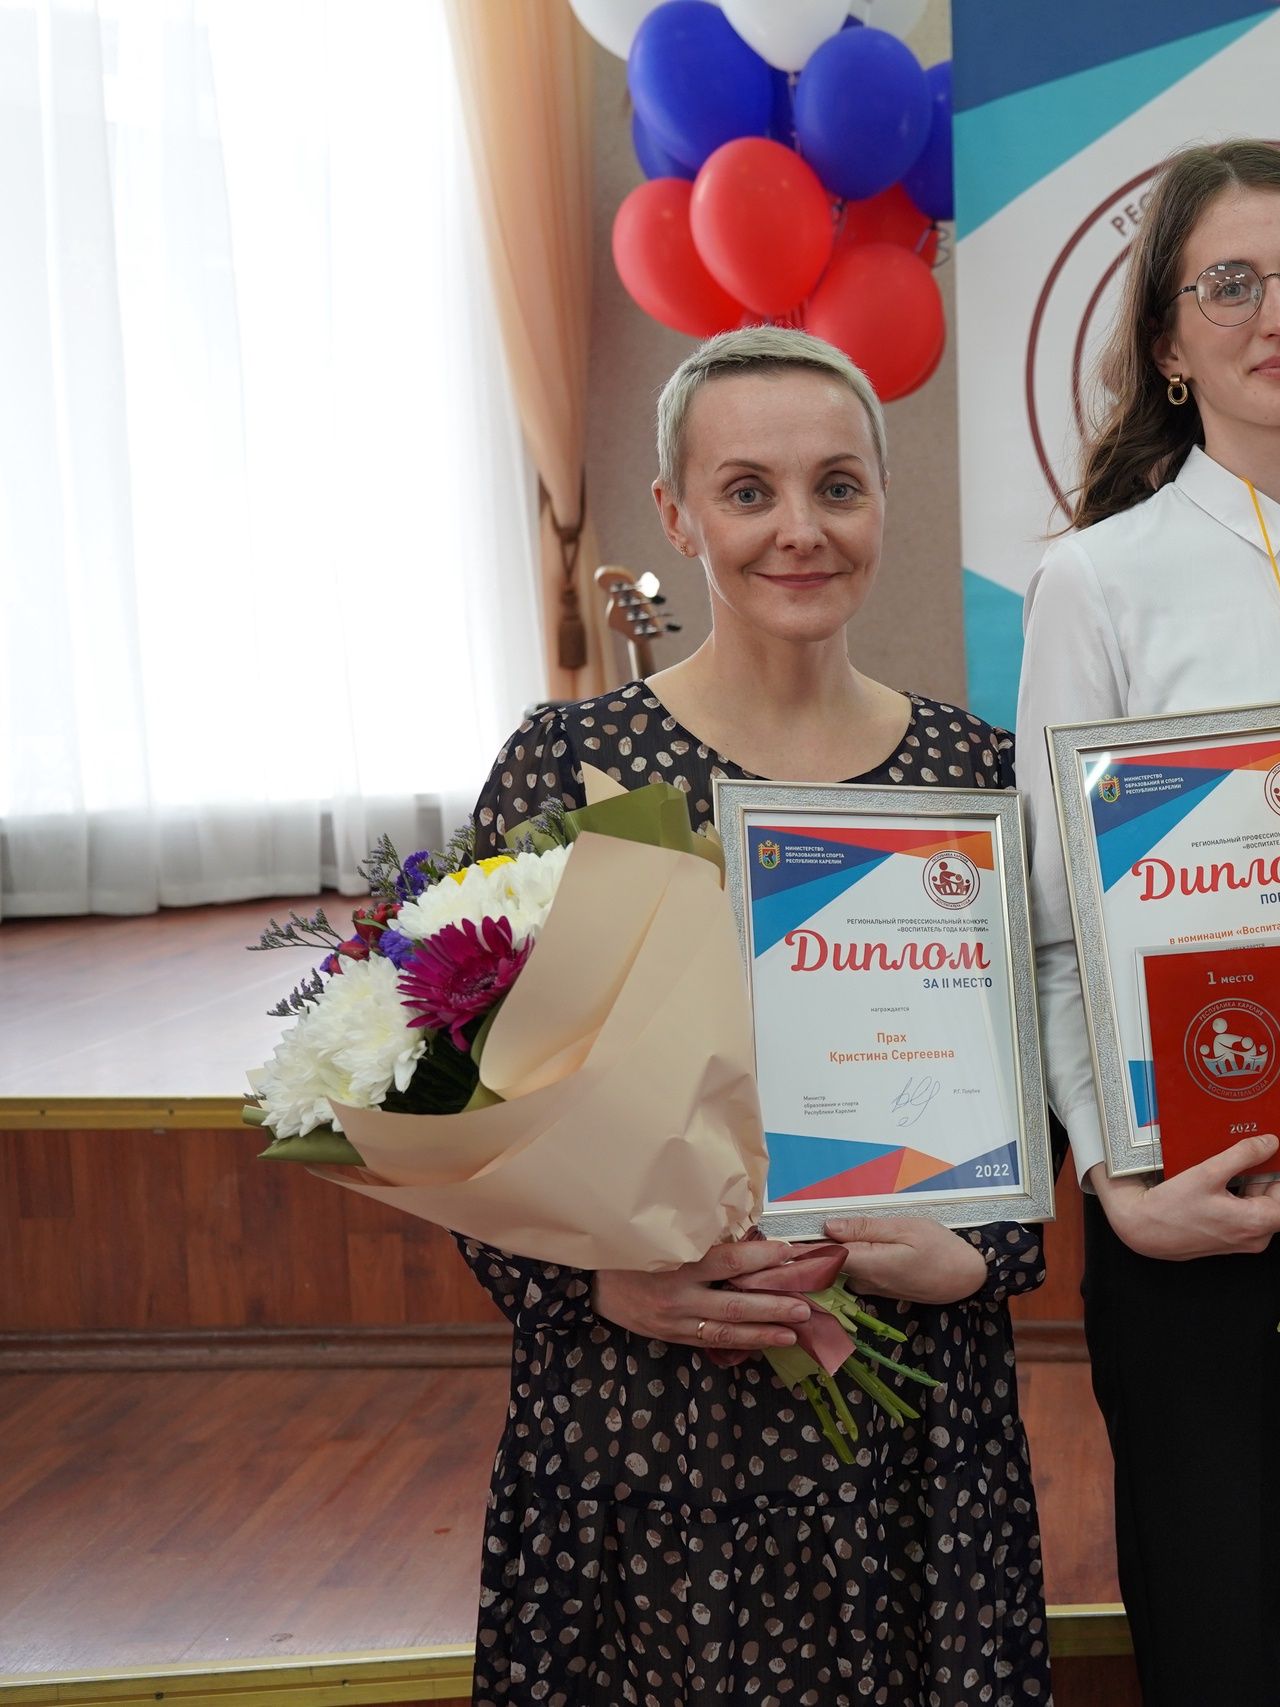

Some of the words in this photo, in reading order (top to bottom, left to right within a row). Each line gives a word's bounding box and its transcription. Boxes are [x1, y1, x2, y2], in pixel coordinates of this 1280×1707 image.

[1124, 773, 1163, 782] МИНИСТЕРСТВО
[1125, 779, 1160, 788] ОБРАЗОВАНИЯ
[1126, 785, 1159, 795] РЕСПУБЛИКИ
[1159, 784, 1182, 792] КАРЕЛИИ
[1191, 836, 1241, 848] РЕГИОНАЛЬНЫЙ
[897, 918, 961, 926] ПРОФЕССИОНАЛЬНЫЙ
[1169, 937, 1175, 945] в
[1177, 929, 1234, 944] номинации
[784, 929, 991, 972] Диплом
[923, 978, 939, 989] ЗА
[942, 978, 949, 989] II
[953, 977, 993, 989] МЕСТО
[1207, 971, 1216, 985] 1
[1220, 973, 1254, 985] место
[876, 1032, 907, 1046] Прах
[829, 1050, 888, 1064] Кристина
[891, 1049, 955, 1062] Сергеевна
[1229, 1123, 1258, 1133] 2022
[975, 1164, 1010, 1178] 2022
